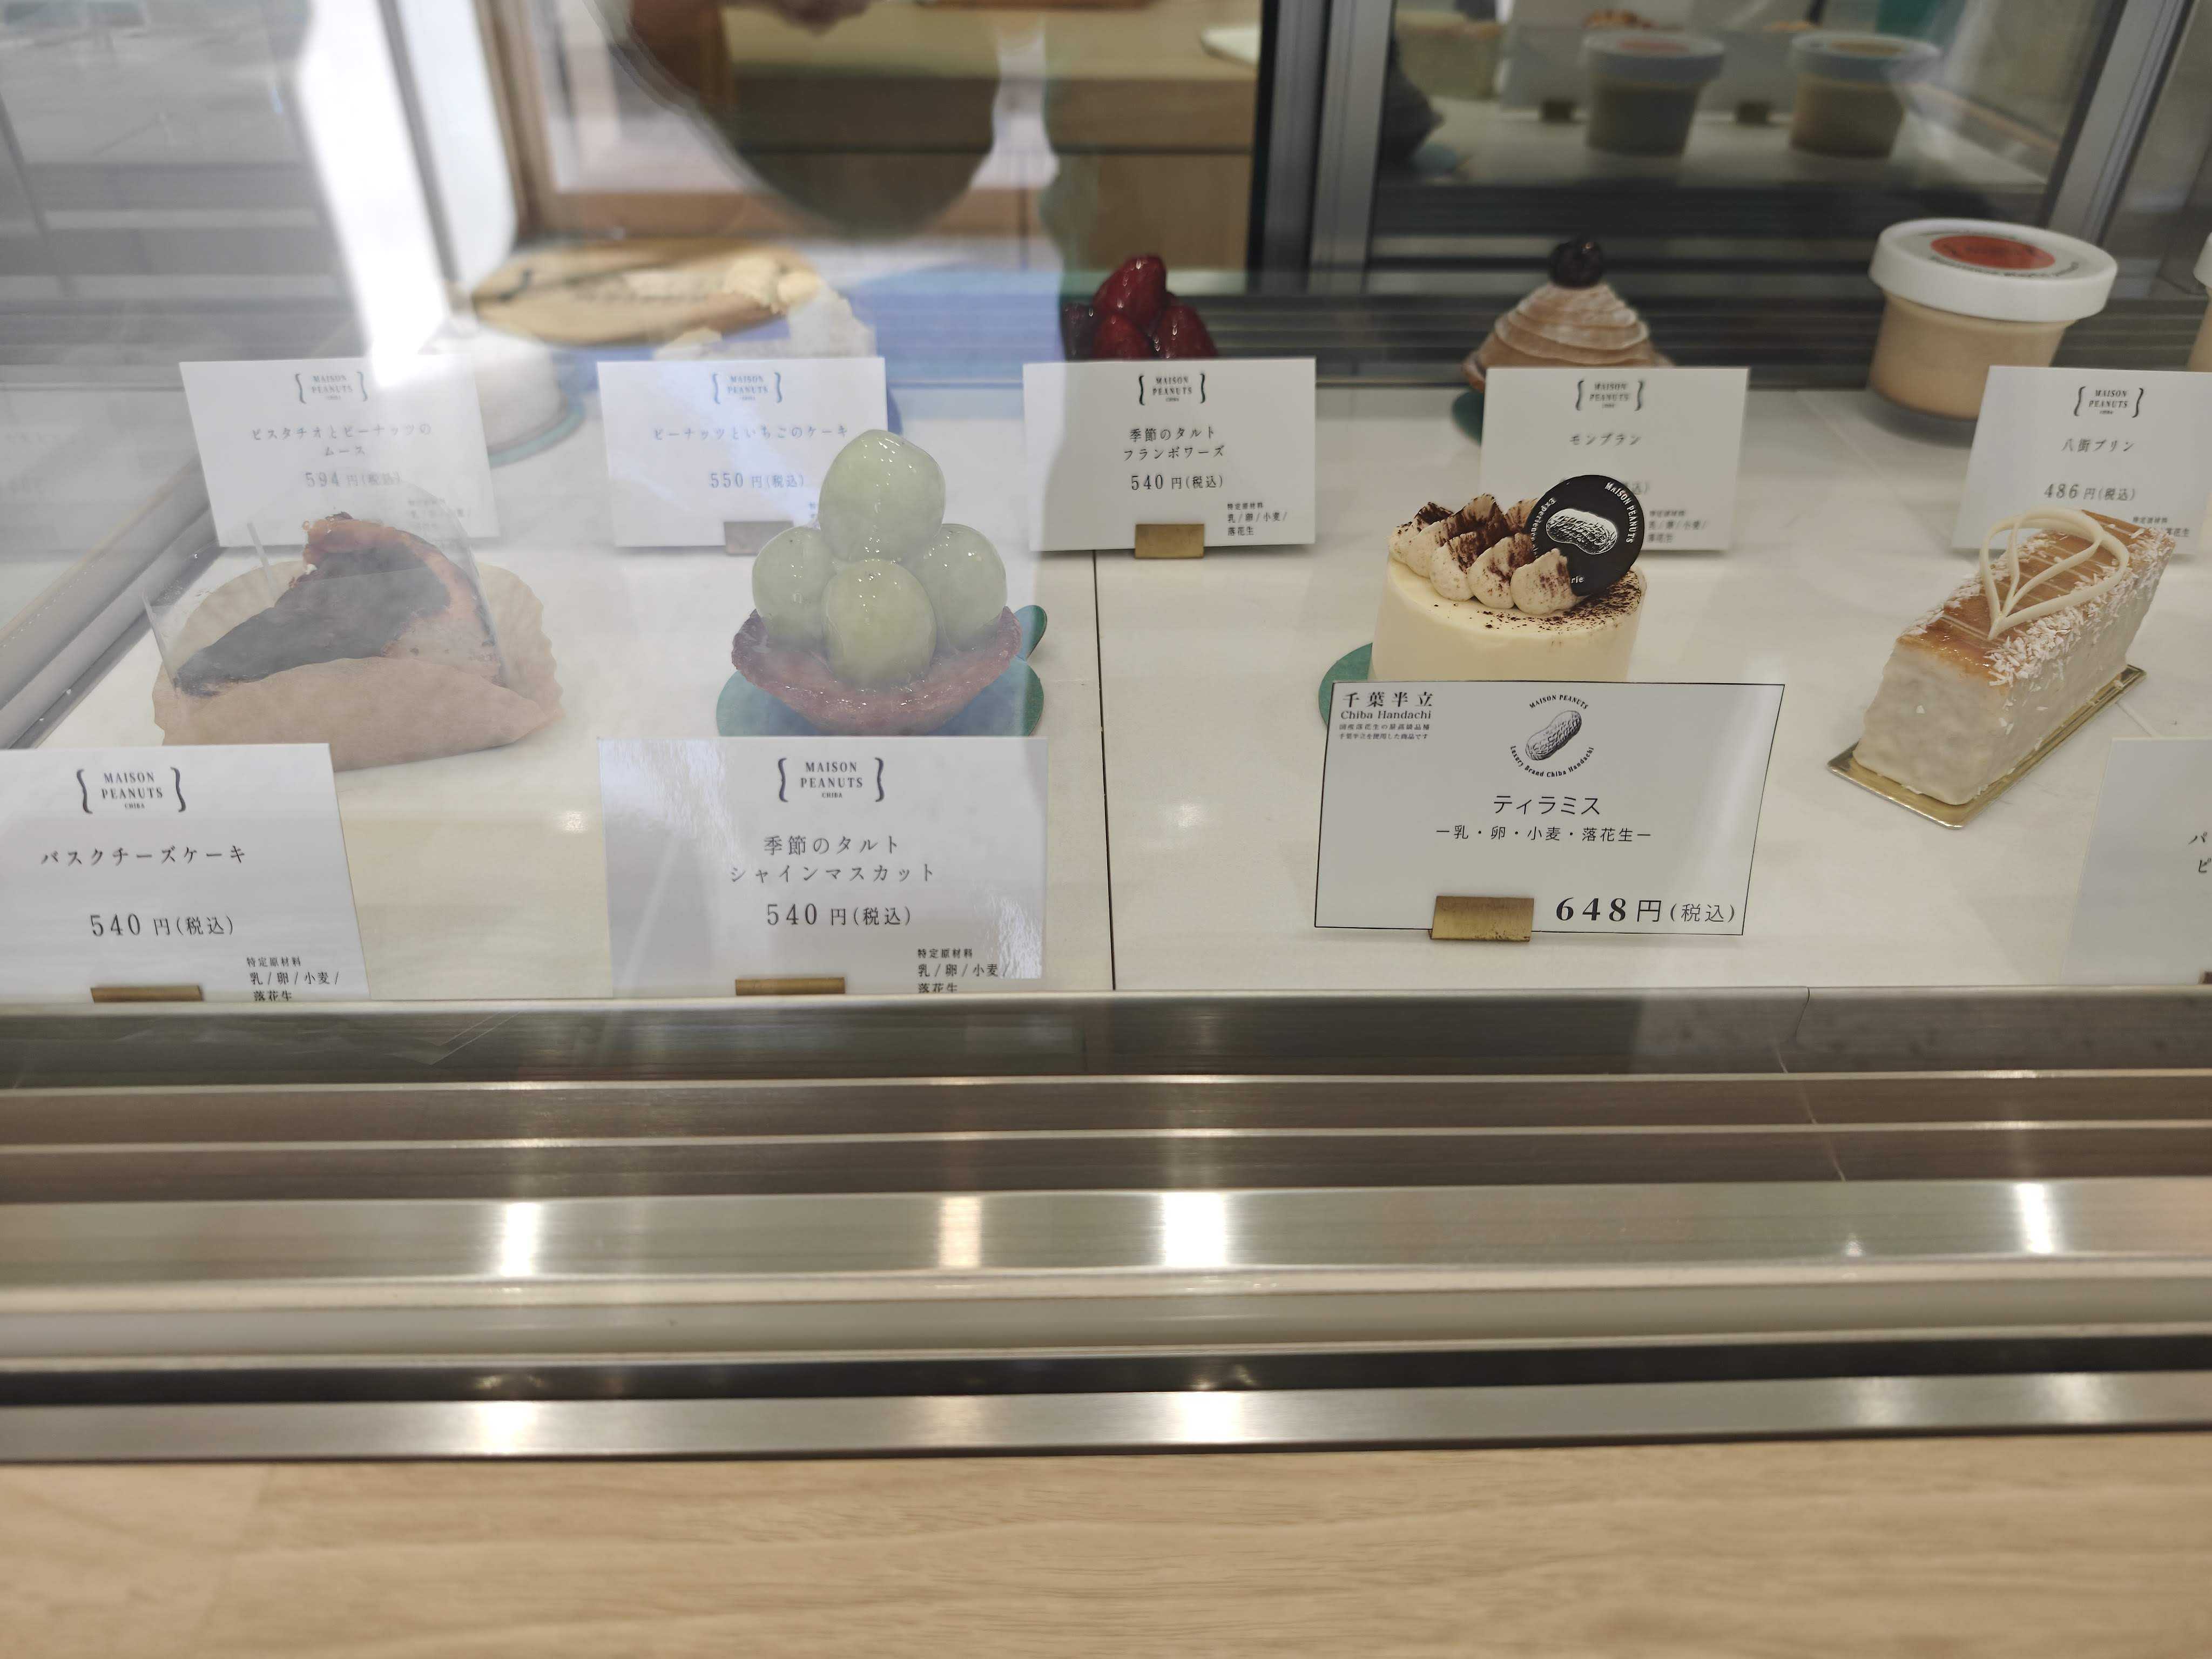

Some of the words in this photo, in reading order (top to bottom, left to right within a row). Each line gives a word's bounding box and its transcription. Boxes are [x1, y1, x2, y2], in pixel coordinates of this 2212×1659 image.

[1153, 387, 1192, 396] PEANUTS
[1130, 427, 1215, 443] 季節のタルト
[1570, 433, 1641, 446] モンブラン
[1123, 446, 1225, 461] フランボワーズ
[2060, 439, 2135, 453] 八街プリン
[711, 472, 744, 489] 550
[1132, 475, 1164, 491] 540
[2044, 483, 2080, 500] 486
[1604, 482, 1631, 507] MAISON
[1626, 504, 1638, 544] PEANUTS
[1343, 692, 1434, 709] 千葉半立
[1529, 695, 1557, 709] MAISON
[1560, 694, 1589, 710] PEANUTS
[1341, 711, 1373, 720] Chiba
[1378, 711, 1432, 719] Handachi
[806, 762, 857, 773] MAISON
[1525, 765, 1544, 777] Brand
[104, 772, 155, 784] MAISON
[801, 778, 863, 788] PEANUTS
[102, 788, 164, 800] PEANUTS
[1494, 796, 1600, 815] ティラミス
[765, 835, 898, 857] 季節のタルト
[42, 846, 246, 867] バスクチーズケーキ
[731, 864, 933, 884] シャインマスカット
[767, 903, 818, 926] 540
[91, 914, 141, 937] 540
[918, 948, 973, 959] 特定原材料
[247, 957, 301, 968] 特定原材料
